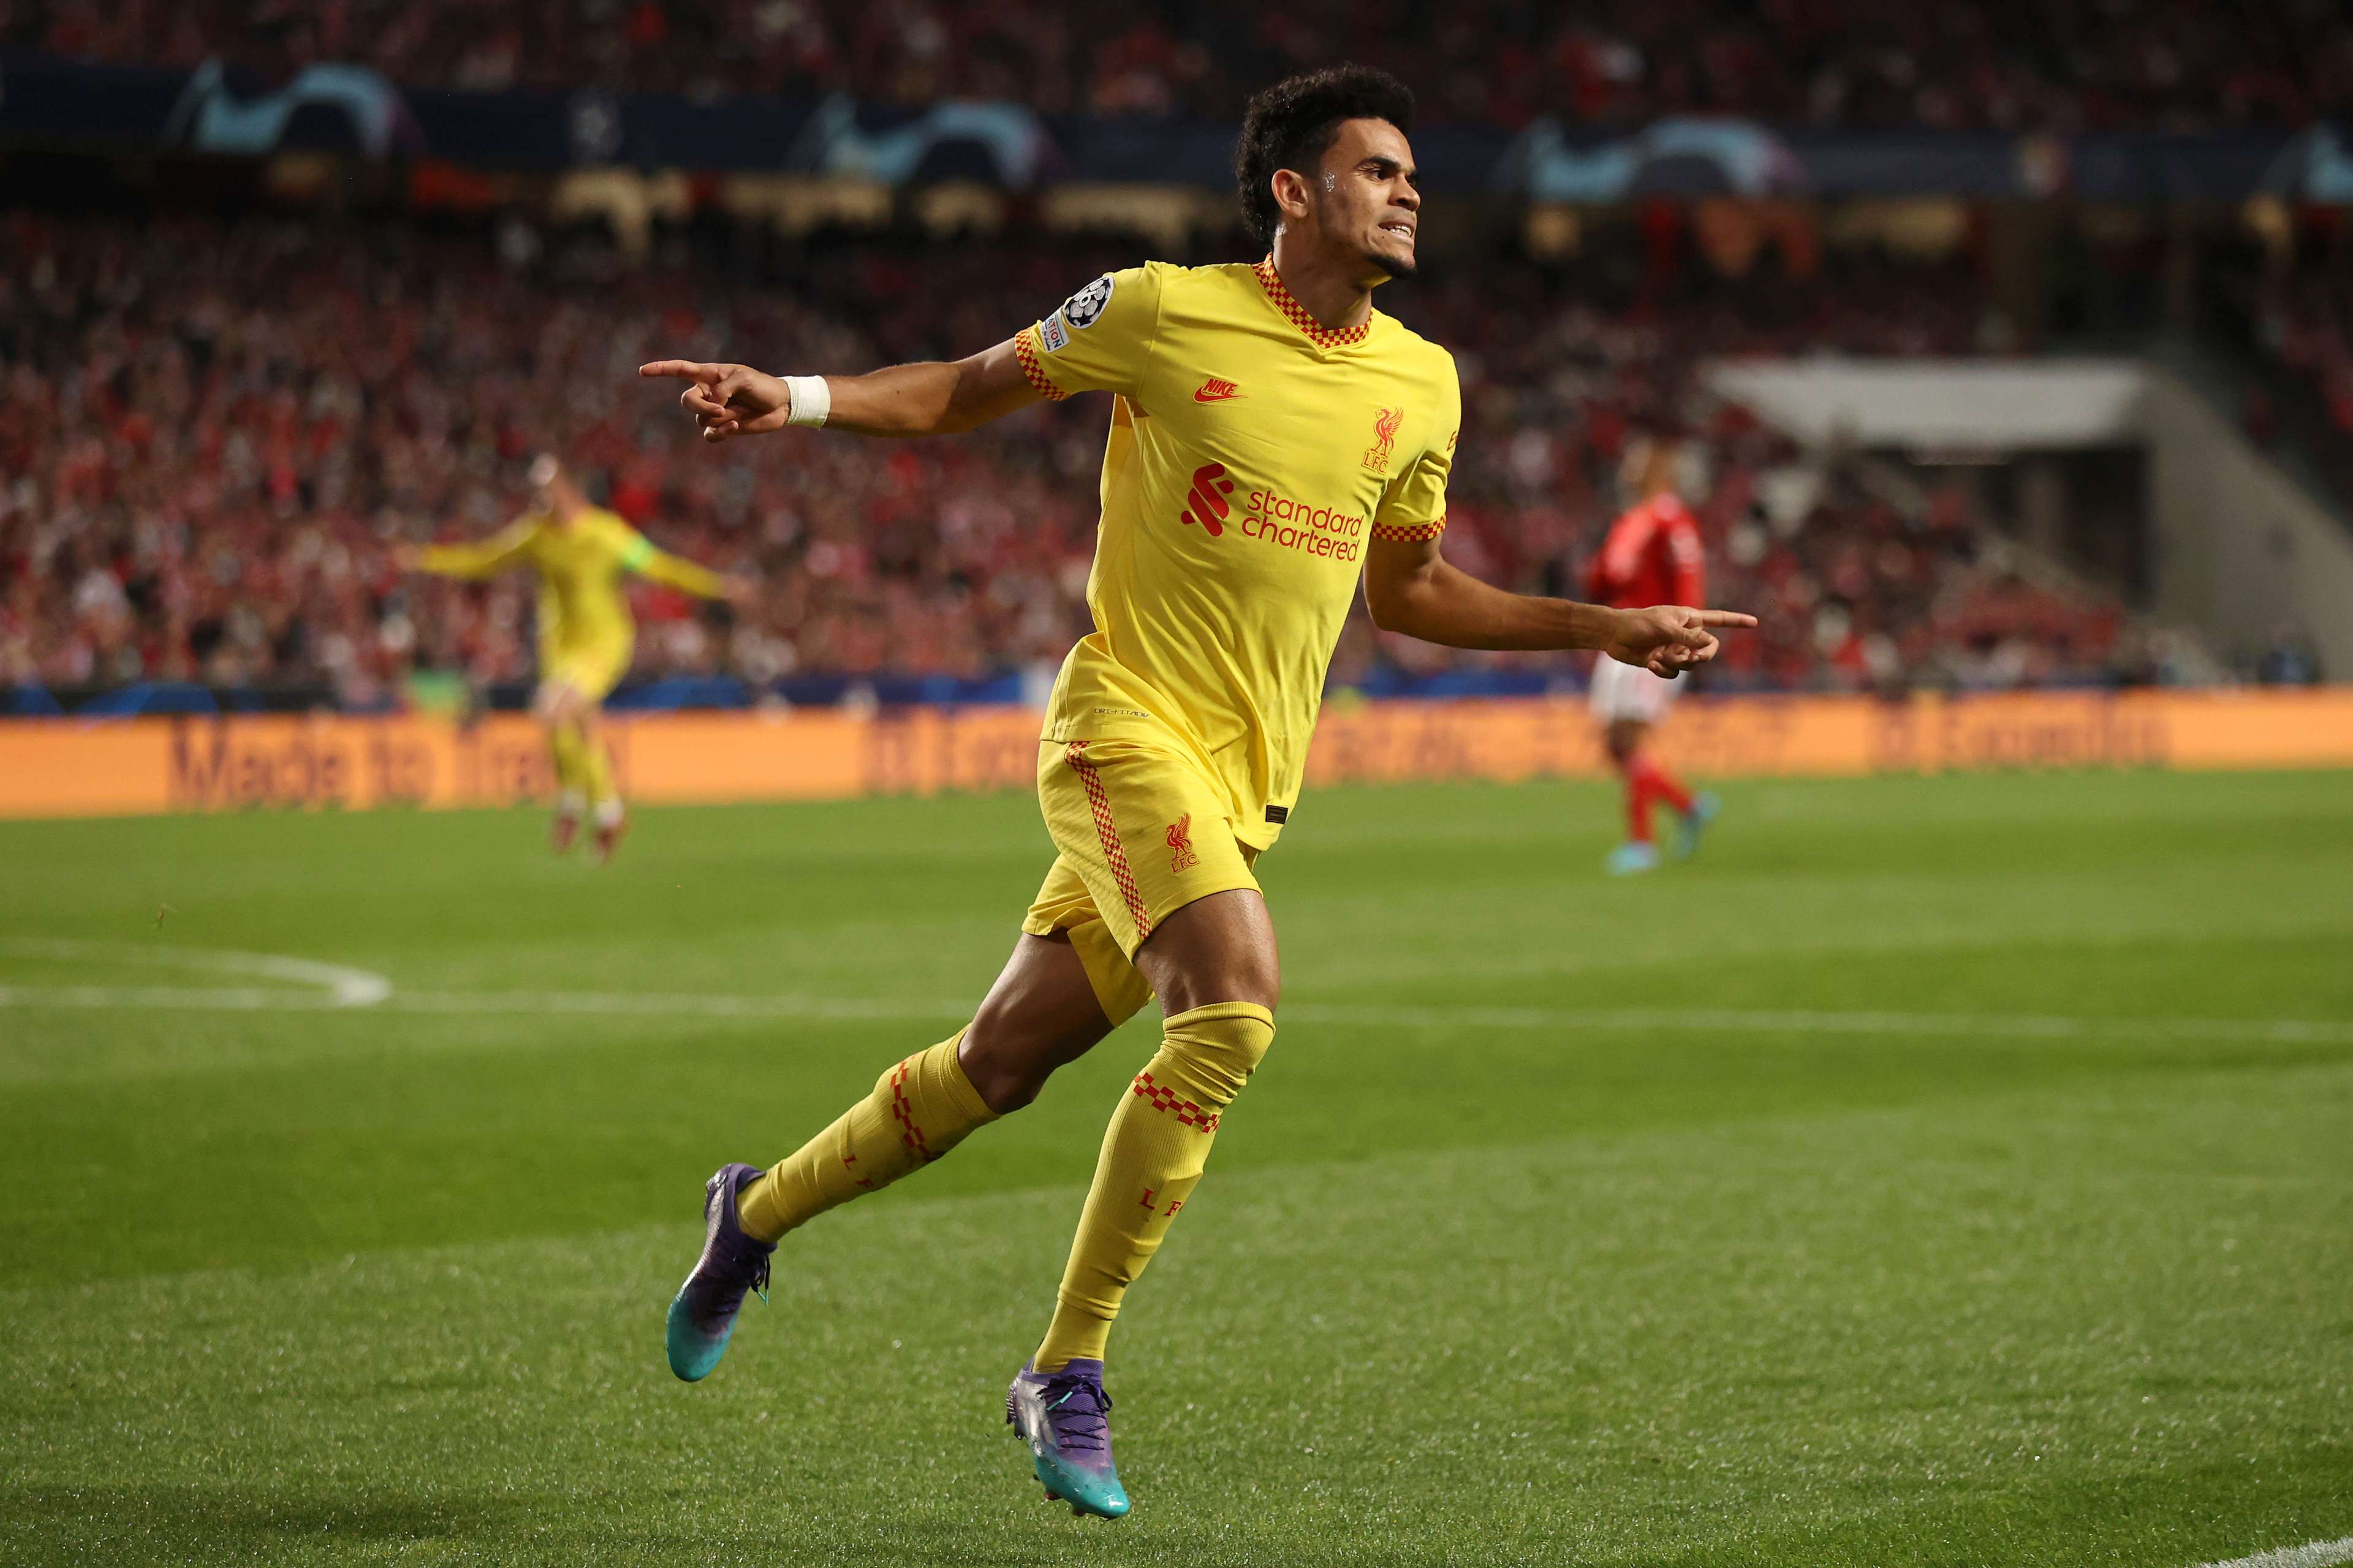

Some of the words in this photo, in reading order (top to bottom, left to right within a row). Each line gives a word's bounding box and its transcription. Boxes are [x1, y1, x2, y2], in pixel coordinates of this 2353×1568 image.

[1047, 318, 1062, 349] ATION
[1202, 378, 1238, 396] NIKE
[1247, 490, 1365, 537] standard
[1242, 516, 1360, 562] chartered
